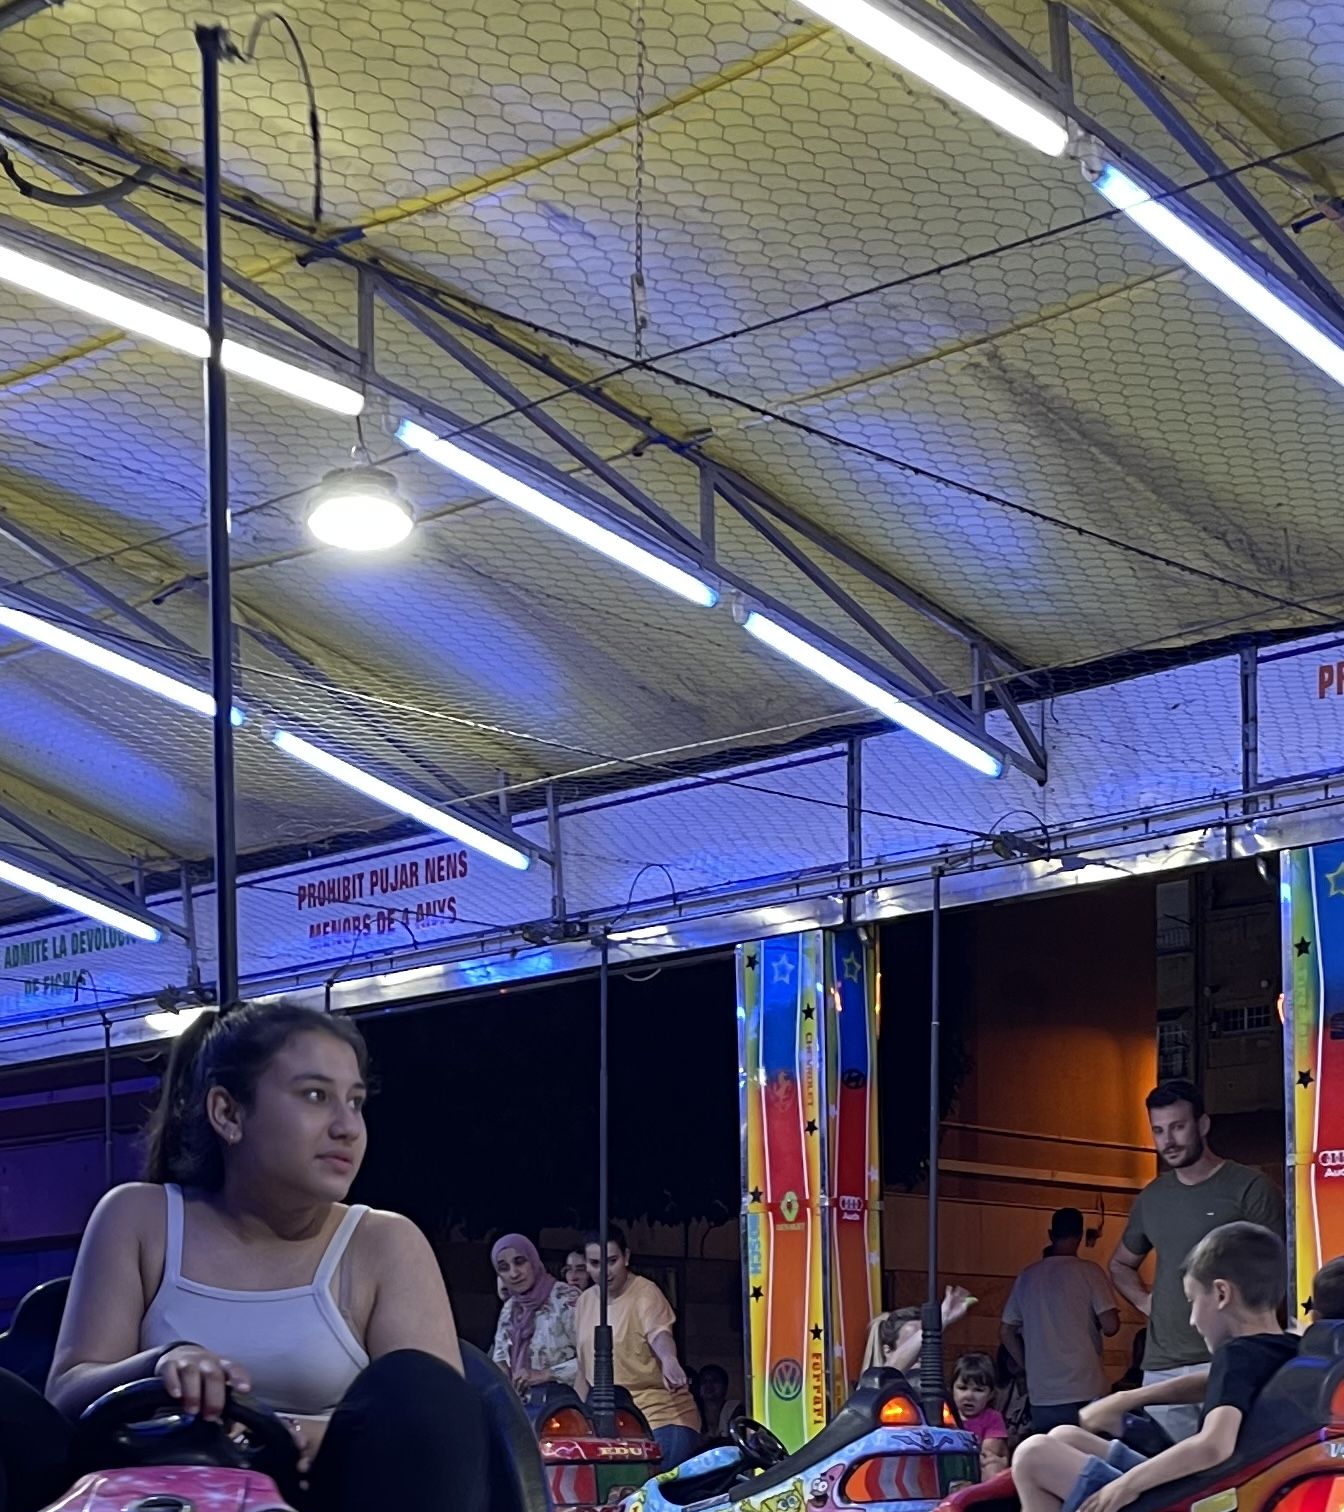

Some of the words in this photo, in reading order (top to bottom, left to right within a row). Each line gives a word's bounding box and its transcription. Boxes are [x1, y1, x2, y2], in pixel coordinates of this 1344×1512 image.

[297, 872, 365, 911] PROHIBIT
[370, 861, 419, 897] PUJAR
[424, 850, 468, 884] NENS
[309, 913, 371, 944] MENORS
[376, 908, 396, 934] DE
[4, 938, 49, 969] ADMITE
[52, 934, 67, 959] LA
[597, 1446, 643, 1456] EDU
